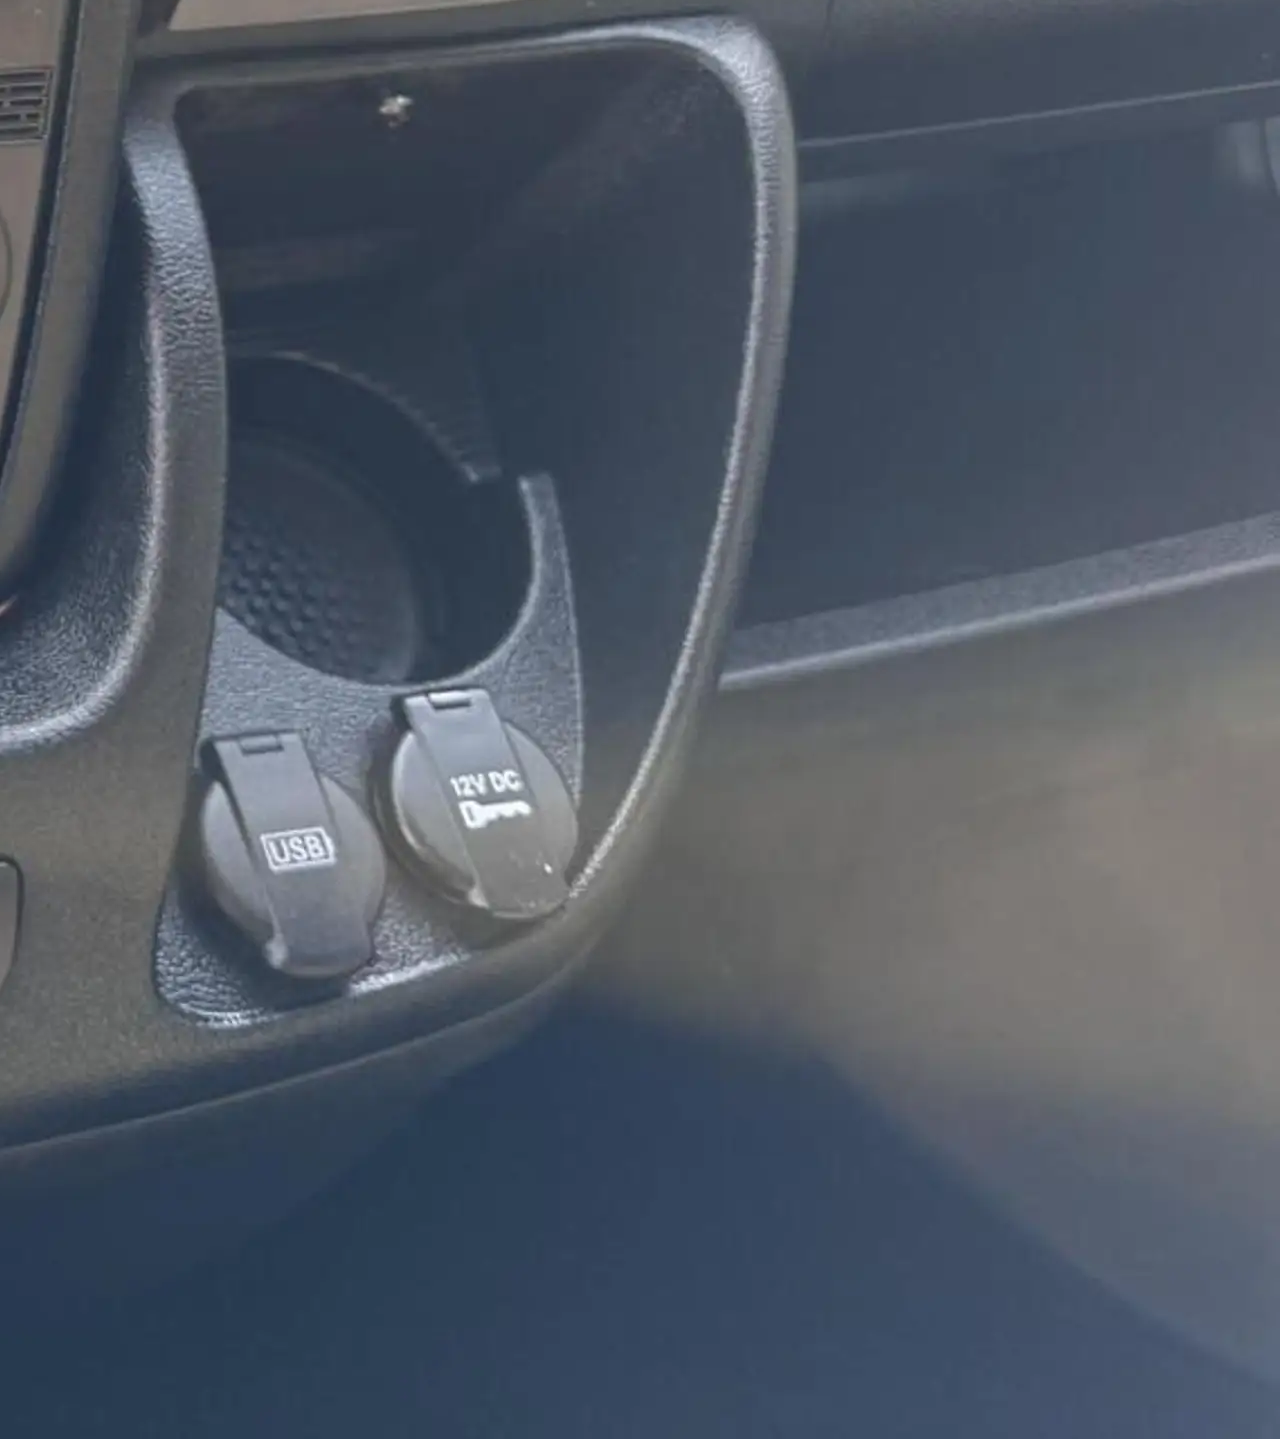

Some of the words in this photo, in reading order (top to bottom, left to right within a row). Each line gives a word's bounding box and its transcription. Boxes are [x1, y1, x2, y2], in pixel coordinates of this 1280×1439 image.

[449, 774, 486, 797] 12V
[489, 769, 524, 794] DC
[268, 835, 325, 864] USB
